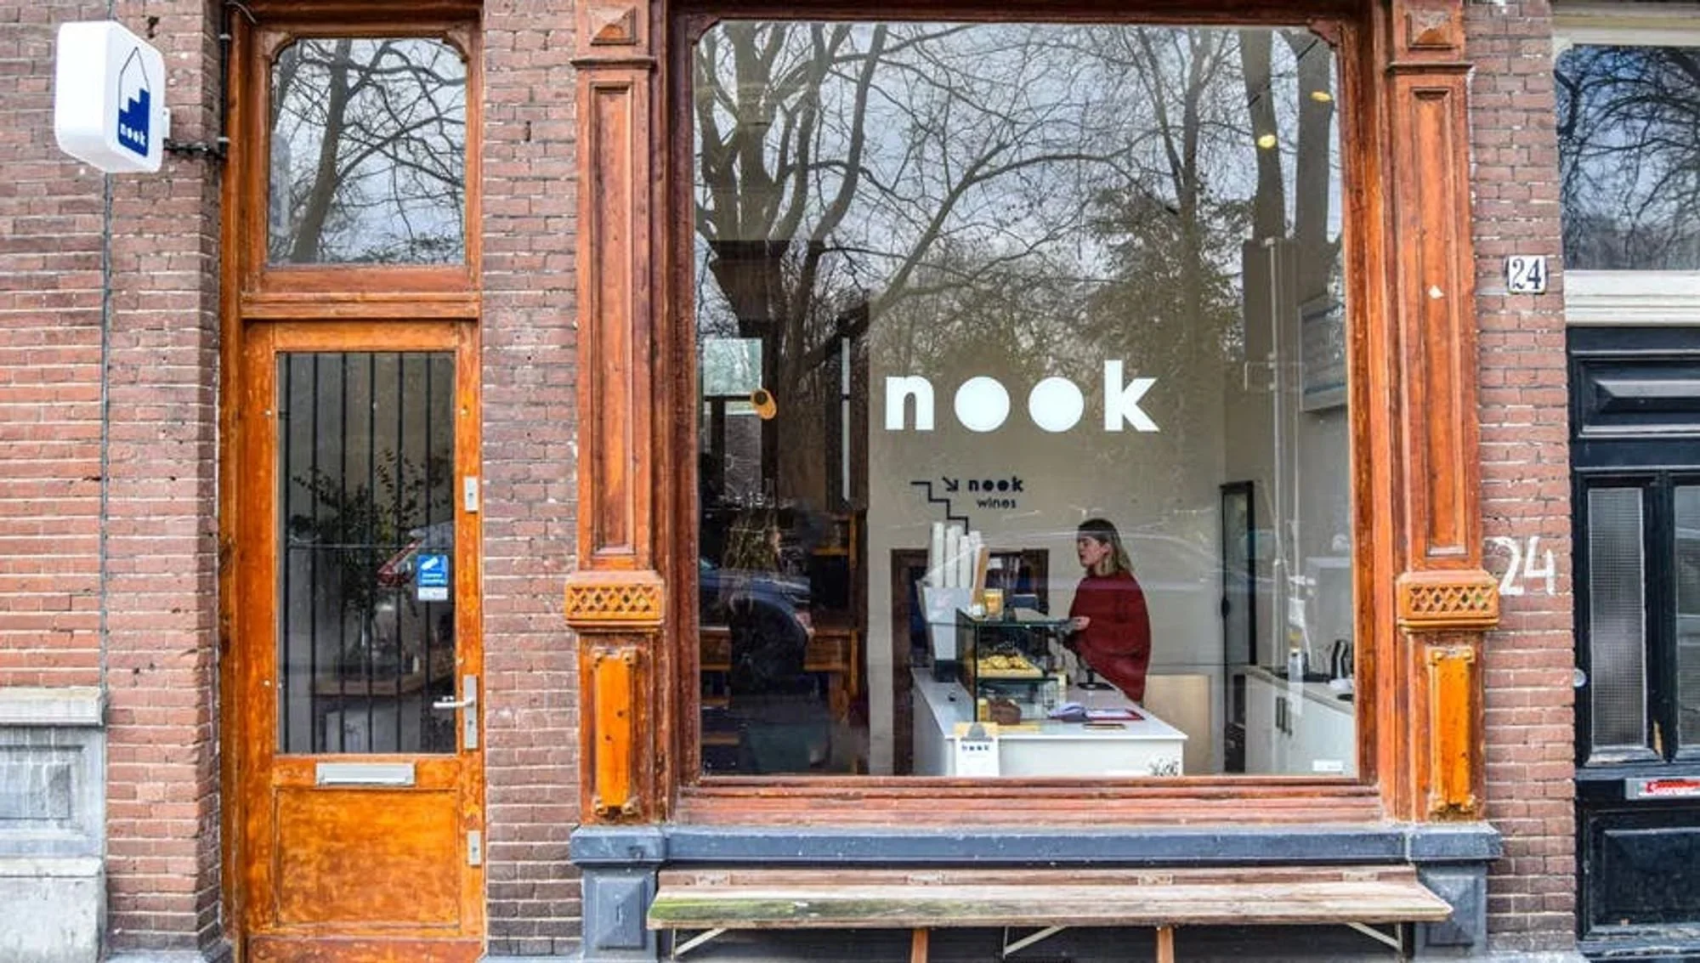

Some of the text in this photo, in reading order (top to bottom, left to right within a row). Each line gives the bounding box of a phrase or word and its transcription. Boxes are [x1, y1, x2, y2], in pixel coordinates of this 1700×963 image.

[120, 124, 146, 146] nook
[1512, 258, 1541, 290] 24
[885, 359, 1160, 433] nook
[968, 475, 1025, 493] nook
[976, 497, 1017, 509] wines
[1483, 536, 1555, 596] 24
